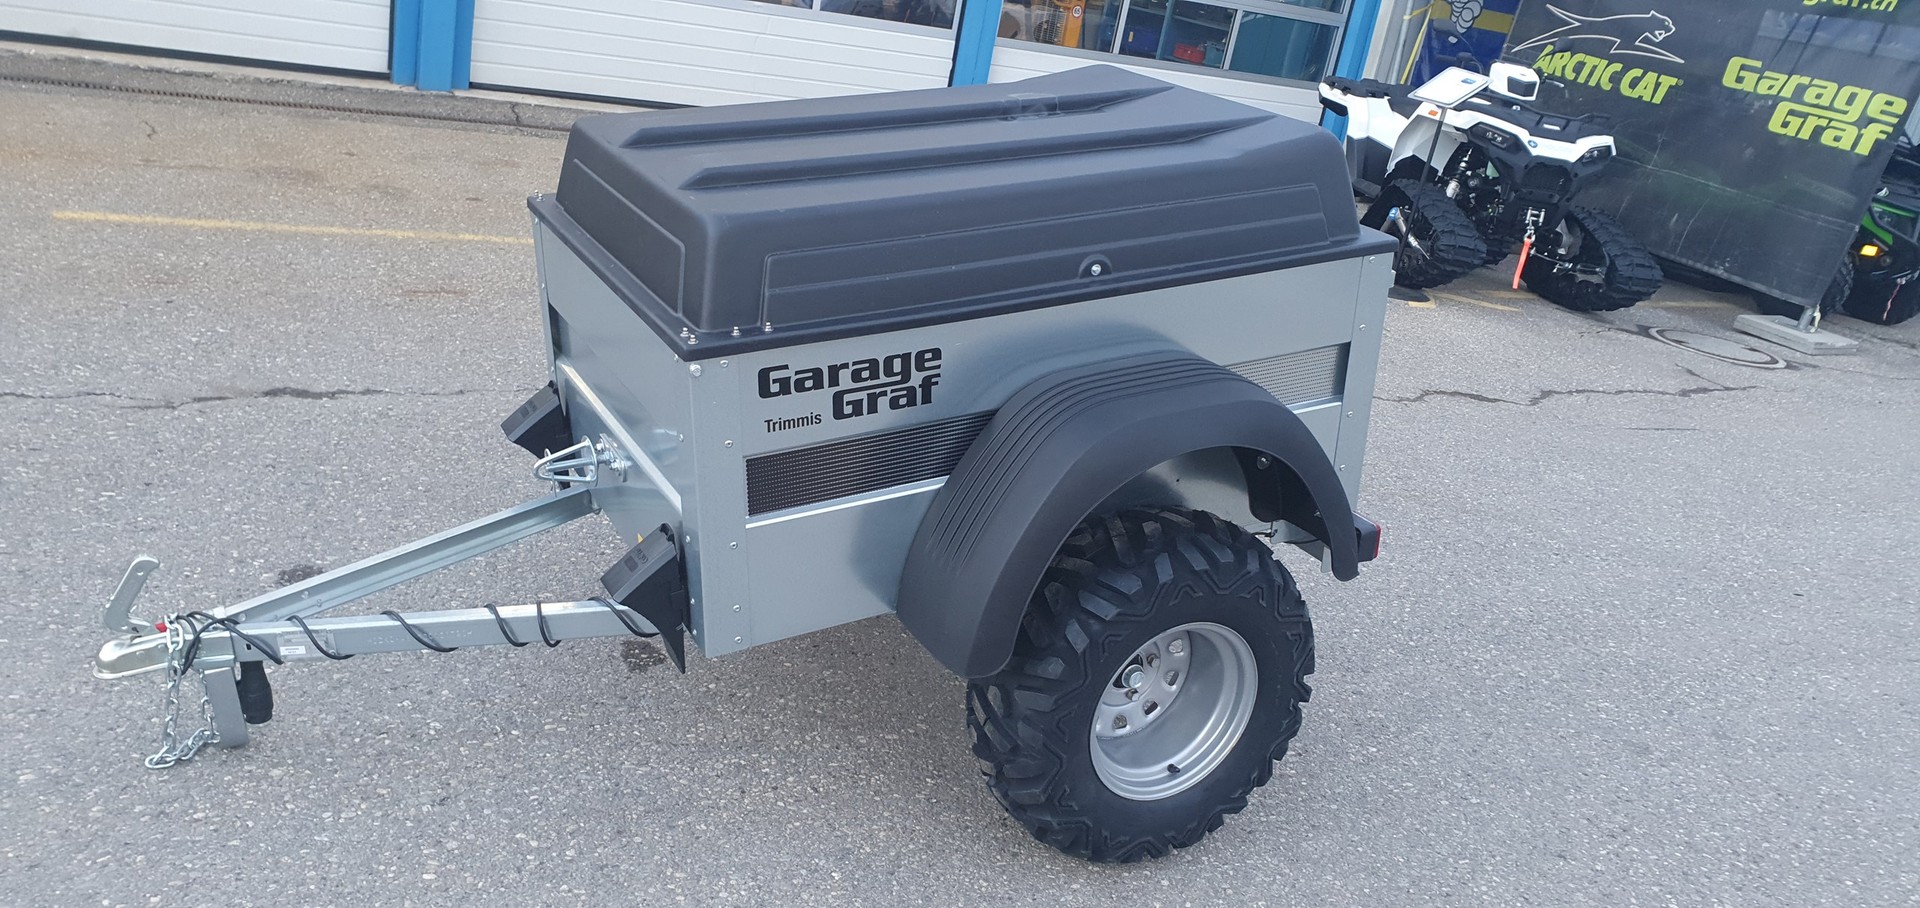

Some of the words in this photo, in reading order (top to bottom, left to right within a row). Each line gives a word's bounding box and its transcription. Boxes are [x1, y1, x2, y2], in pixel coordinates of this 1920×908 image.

[1532, 44, 1624, 91] ARCTIC
[1620, 67, 1679, 105] CAT
[1722, 56, 1908, 124] Garage
[1768, 101, 1894, 157] Graf
[757, 347, 943, 399] Garage
[832, 373, 942, 421] Graf
[764, 412, 822, 433] Trimmis
